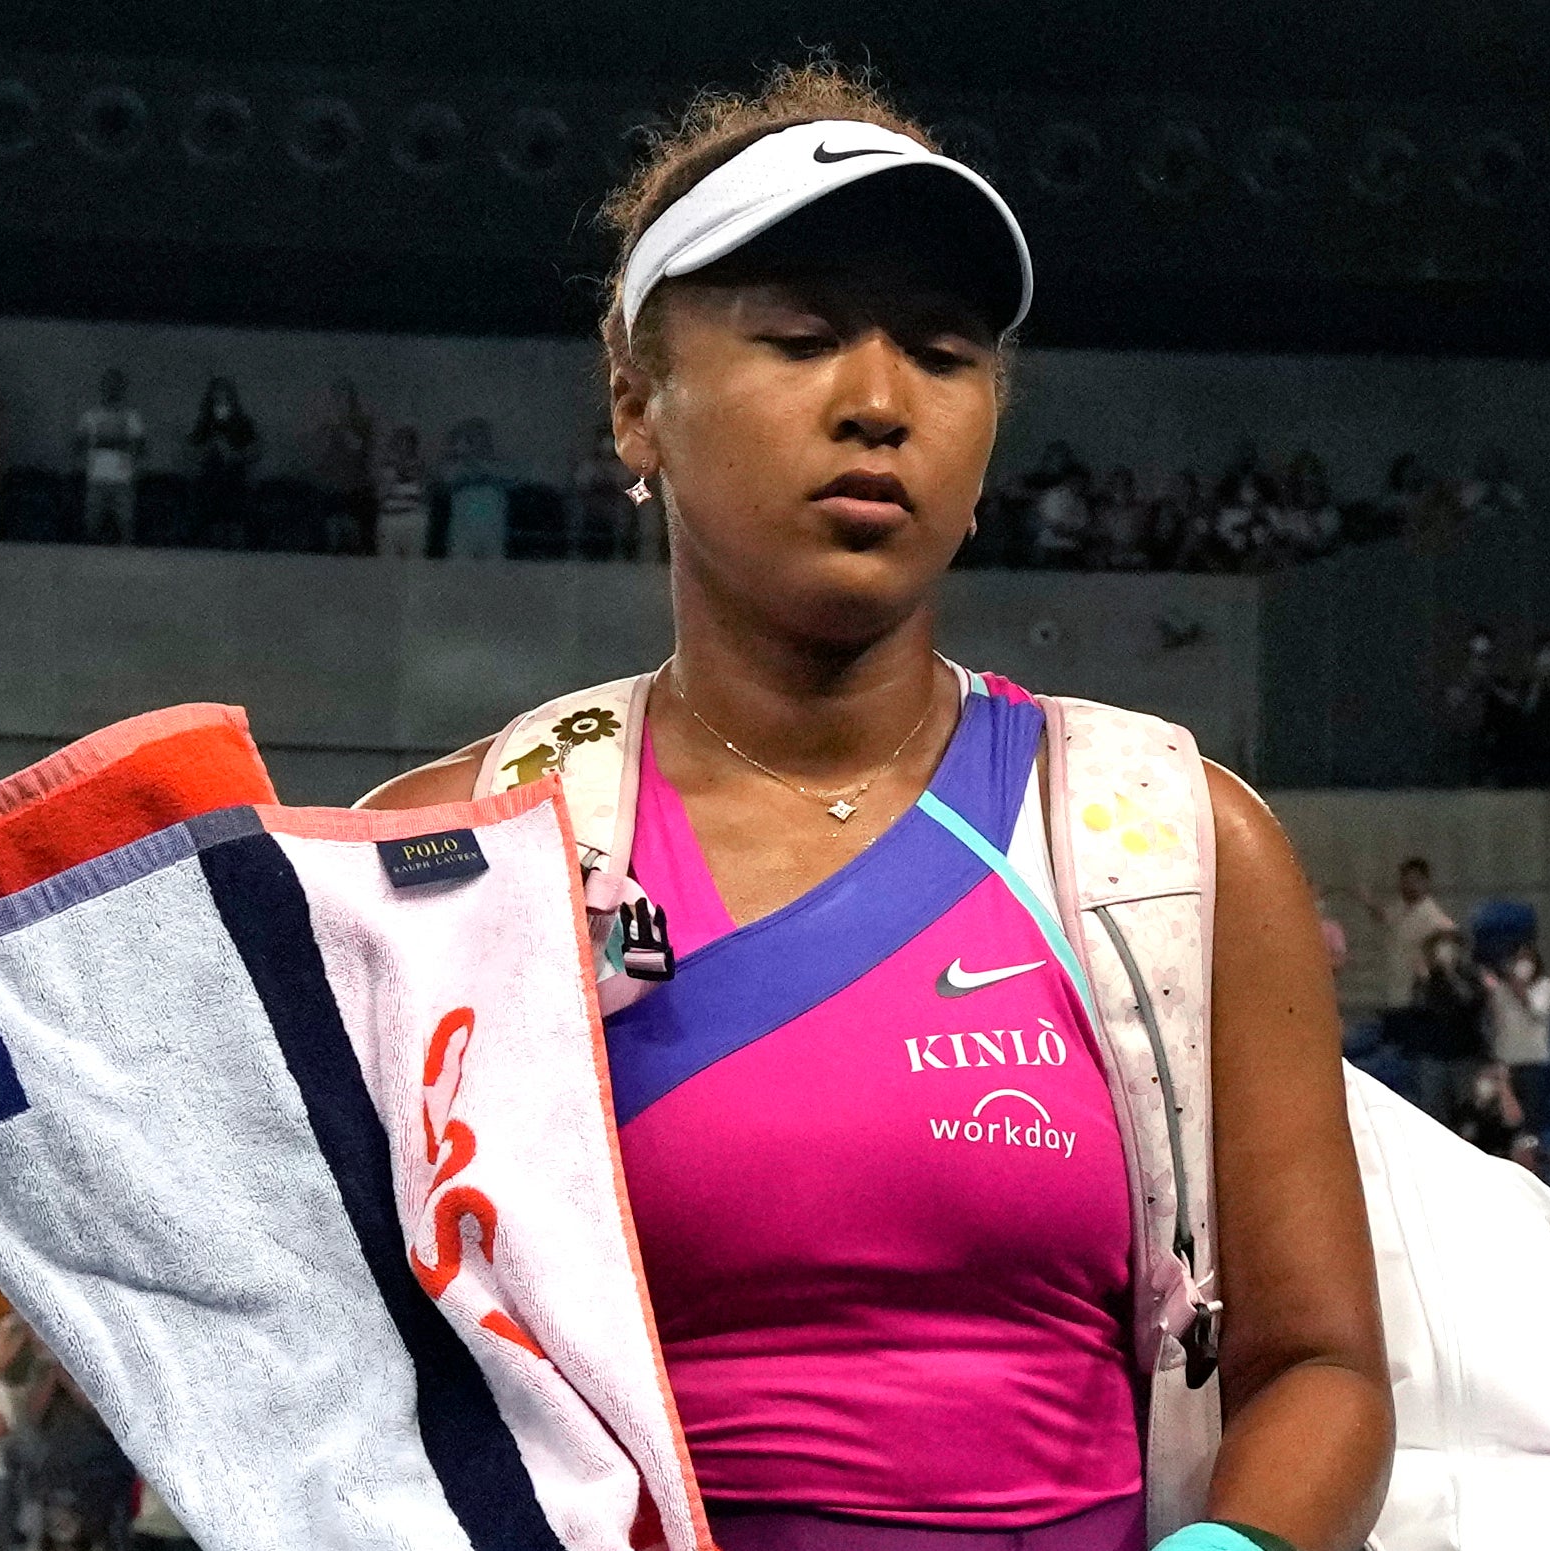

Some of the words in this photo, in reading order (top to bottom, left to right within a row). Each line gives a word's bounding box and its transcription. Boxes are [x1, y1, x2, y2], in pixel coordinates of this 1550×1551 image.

[392, 860, 431, 874] RALPH
[435, 850, 480, 866] LAUREN
[401, 837, 459, 861] POLO
[904, 1017, 1067, 1073] KINLÒ
[929, 1116, 1077, 1159] workday
